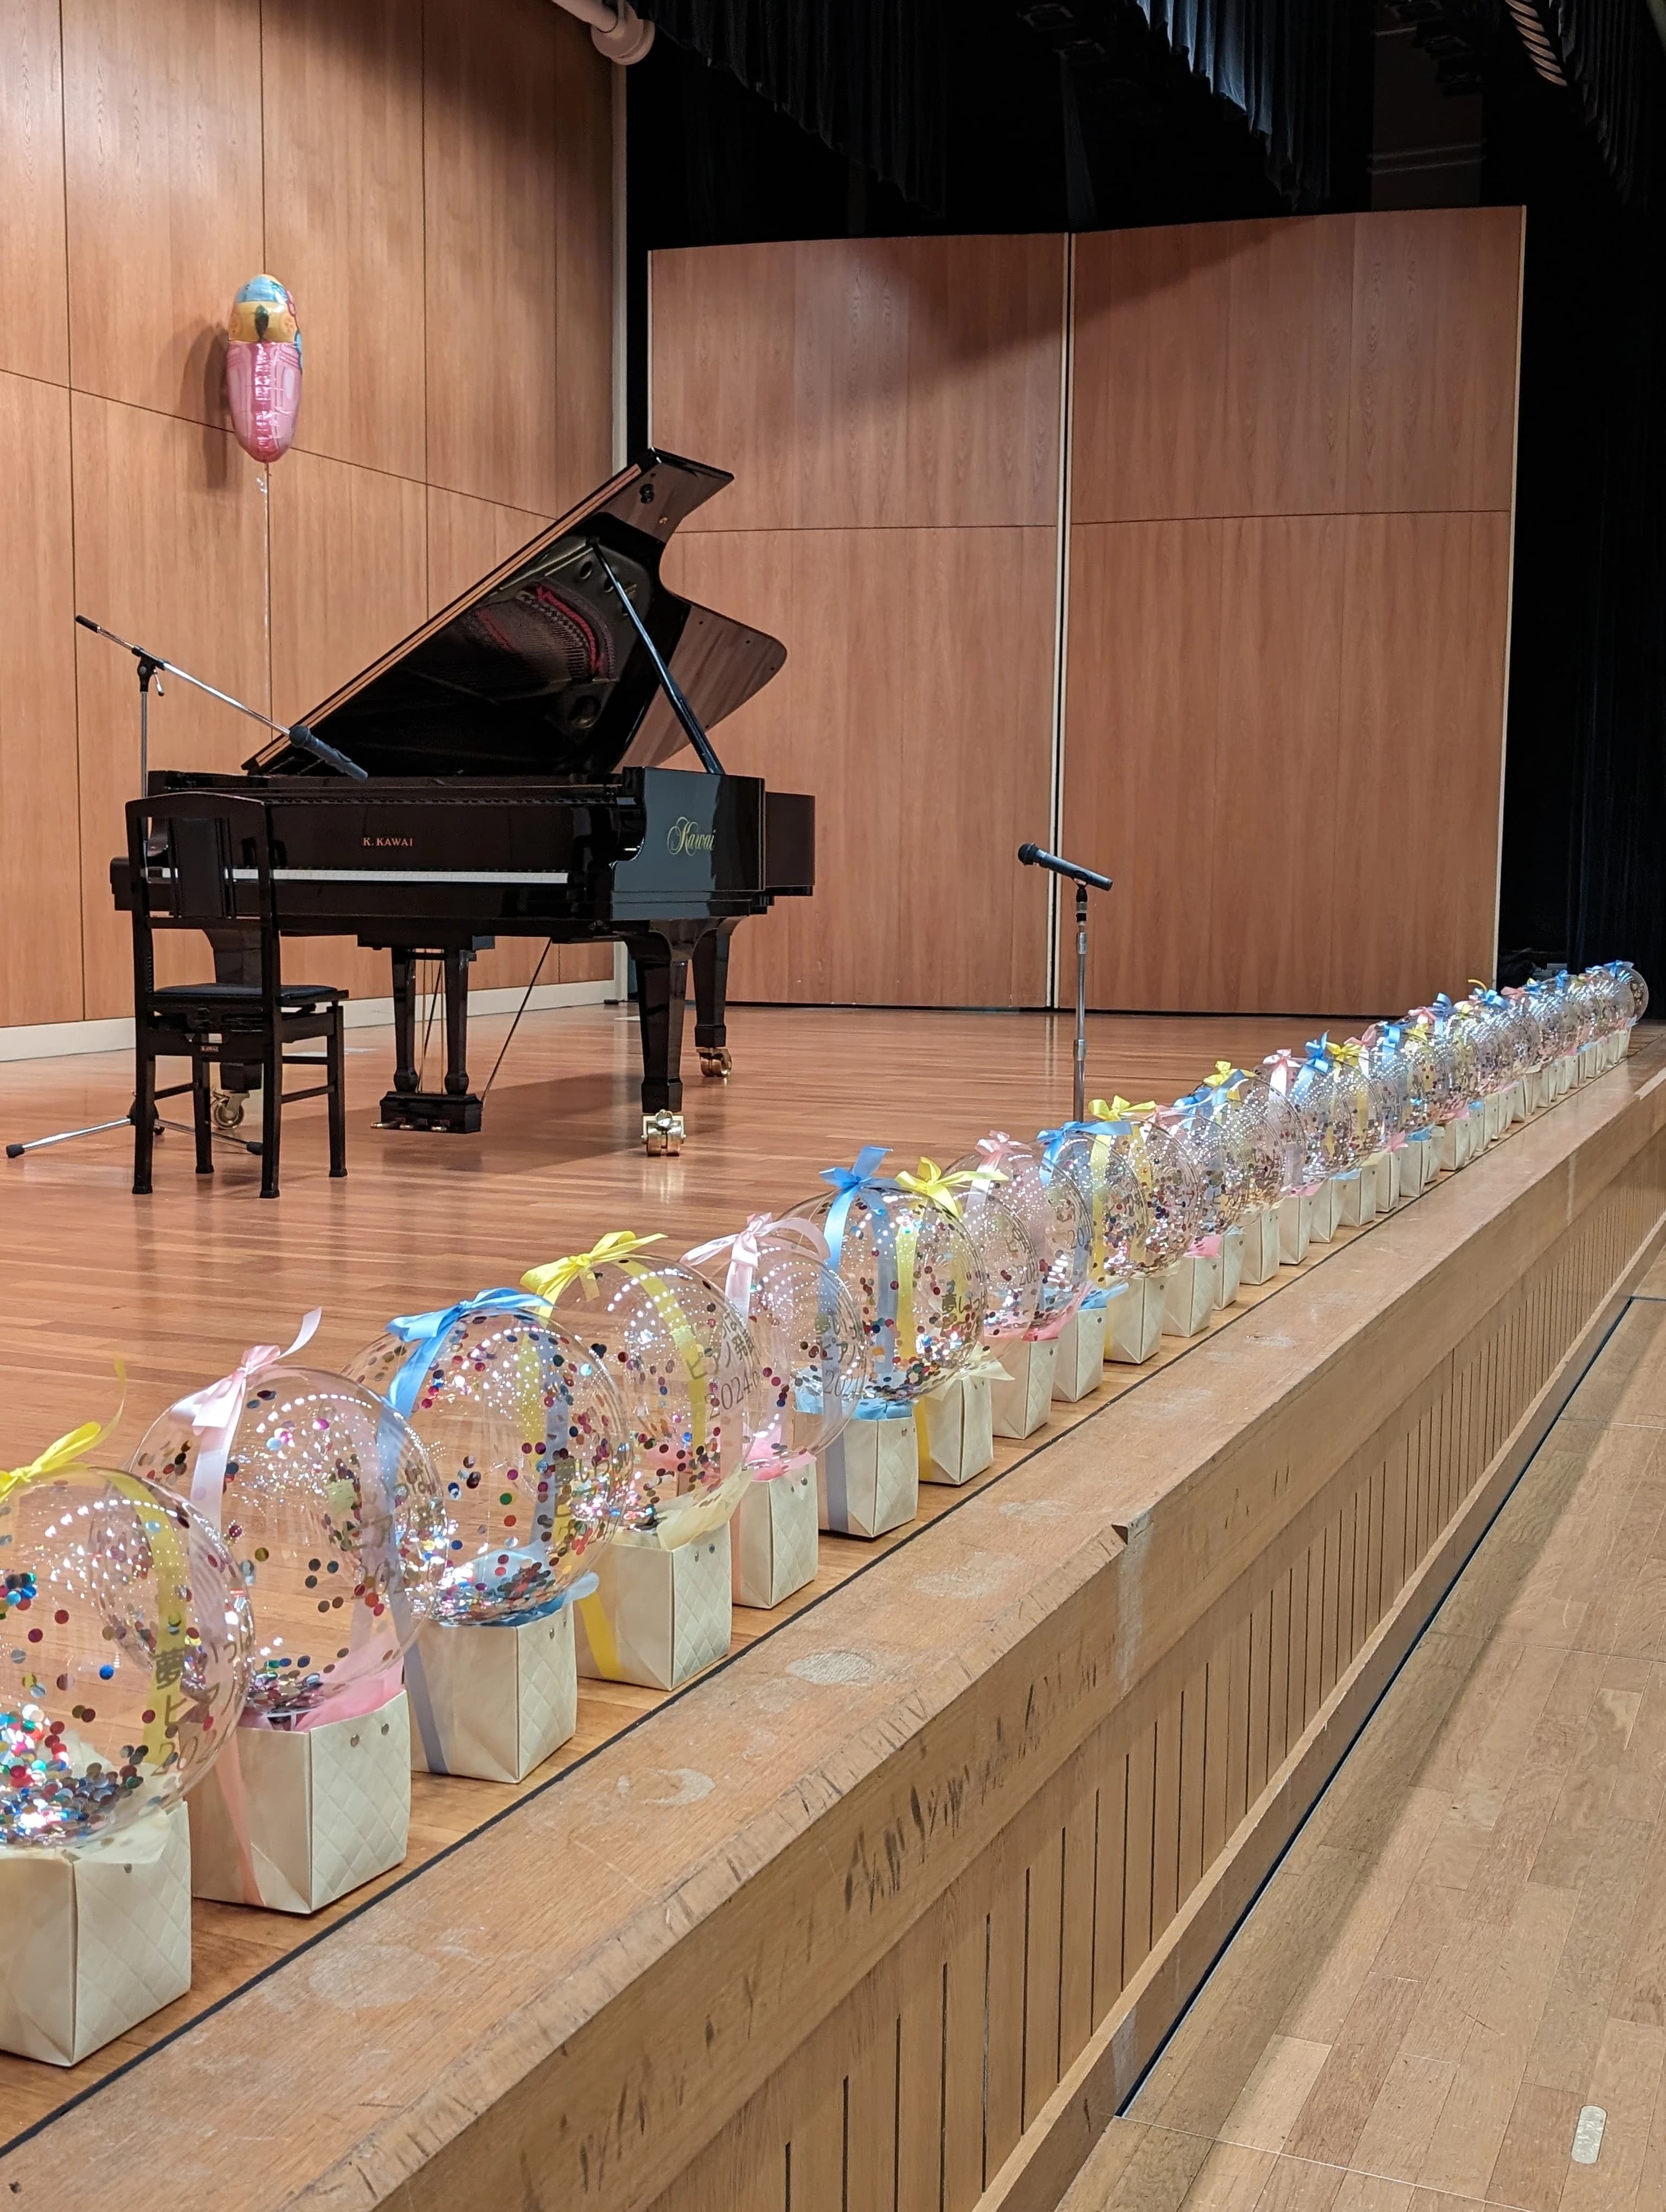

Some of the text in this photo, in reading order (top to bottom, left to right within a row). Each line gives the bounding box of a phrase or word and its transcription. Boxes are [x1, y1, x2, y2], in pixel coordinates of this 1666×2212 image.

[363, 837, 413, 846] K. KAWAI
[667, 816, 716, 856] Kawai
